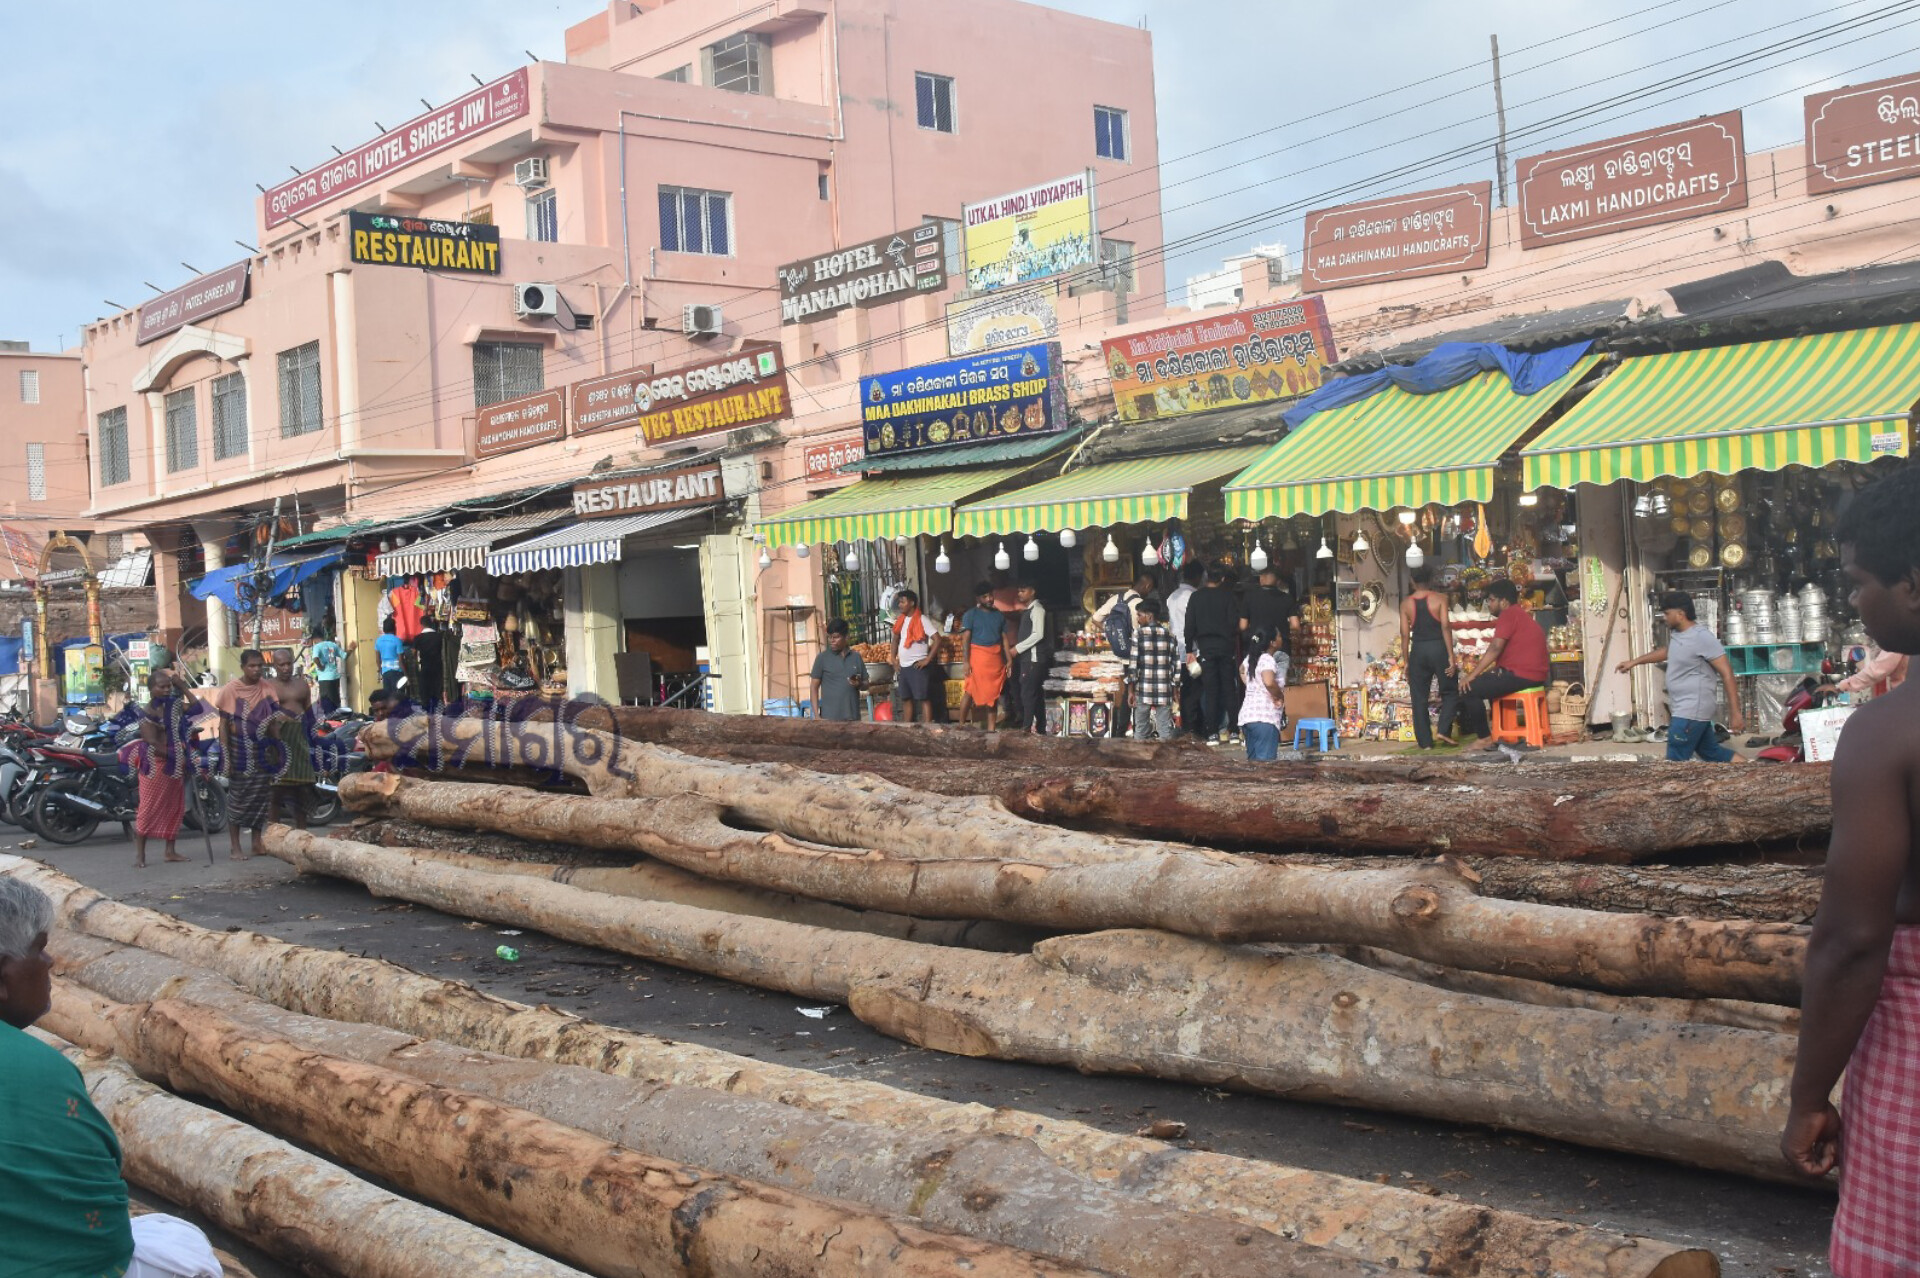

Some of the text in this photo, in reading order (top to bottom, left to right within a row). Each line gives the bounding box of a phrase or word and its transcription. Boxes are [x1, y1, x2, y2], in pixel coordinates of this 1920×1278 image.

[365, 136, 407, 176] HOTEL
[409, 112, 456, 153] SHREE
[459, 97, 486, 131] JIW
[1847, 133, 1920, 167] STEEL
[1560, 163, 1595, 190] ଲକ୍ଷ୍ମୀ
[272, 178, 318, 213] ହୋଟେଲ
[968, 205, 999, 226] UTKAL
[1001, 193, 1028, 217] HINDI
[1031, 179, 1083, 208] VIDYAPITH
[1541, 173, 1719, 225] LAXMI HANDICRAFTS
[354, 229, 498, 271] RESTAURANT
[813, 245, 883, 282] HOTEL
[1318, 234, 1469, 269] MAA DAKHINAKALI HANDICRAFTS
[184, 292, 203, 311] HOTEL
[203, 284, 225, 304] SHREE
[781, 265, 917, 322] MANAMOHAN
[1252, 305, 1304, 322] 8327775020
[907, 373, 957, 394] ଦକ୍ଷିଣକାଳୀ
[1135, 361, 1154, 384] ମା
[1155, 350, 1231, 379] ଦକ୍ଷିଣକାଳୀ
[639, 386, 783, 440] VEG RESTAURANT
[865, 378, 1047, 421] MAA DAKHINAKALI BRASS SHOP
[519, 419, 557, 437] HANDICRAFTS
[572, 470, 720, 515] RESTAURANT
